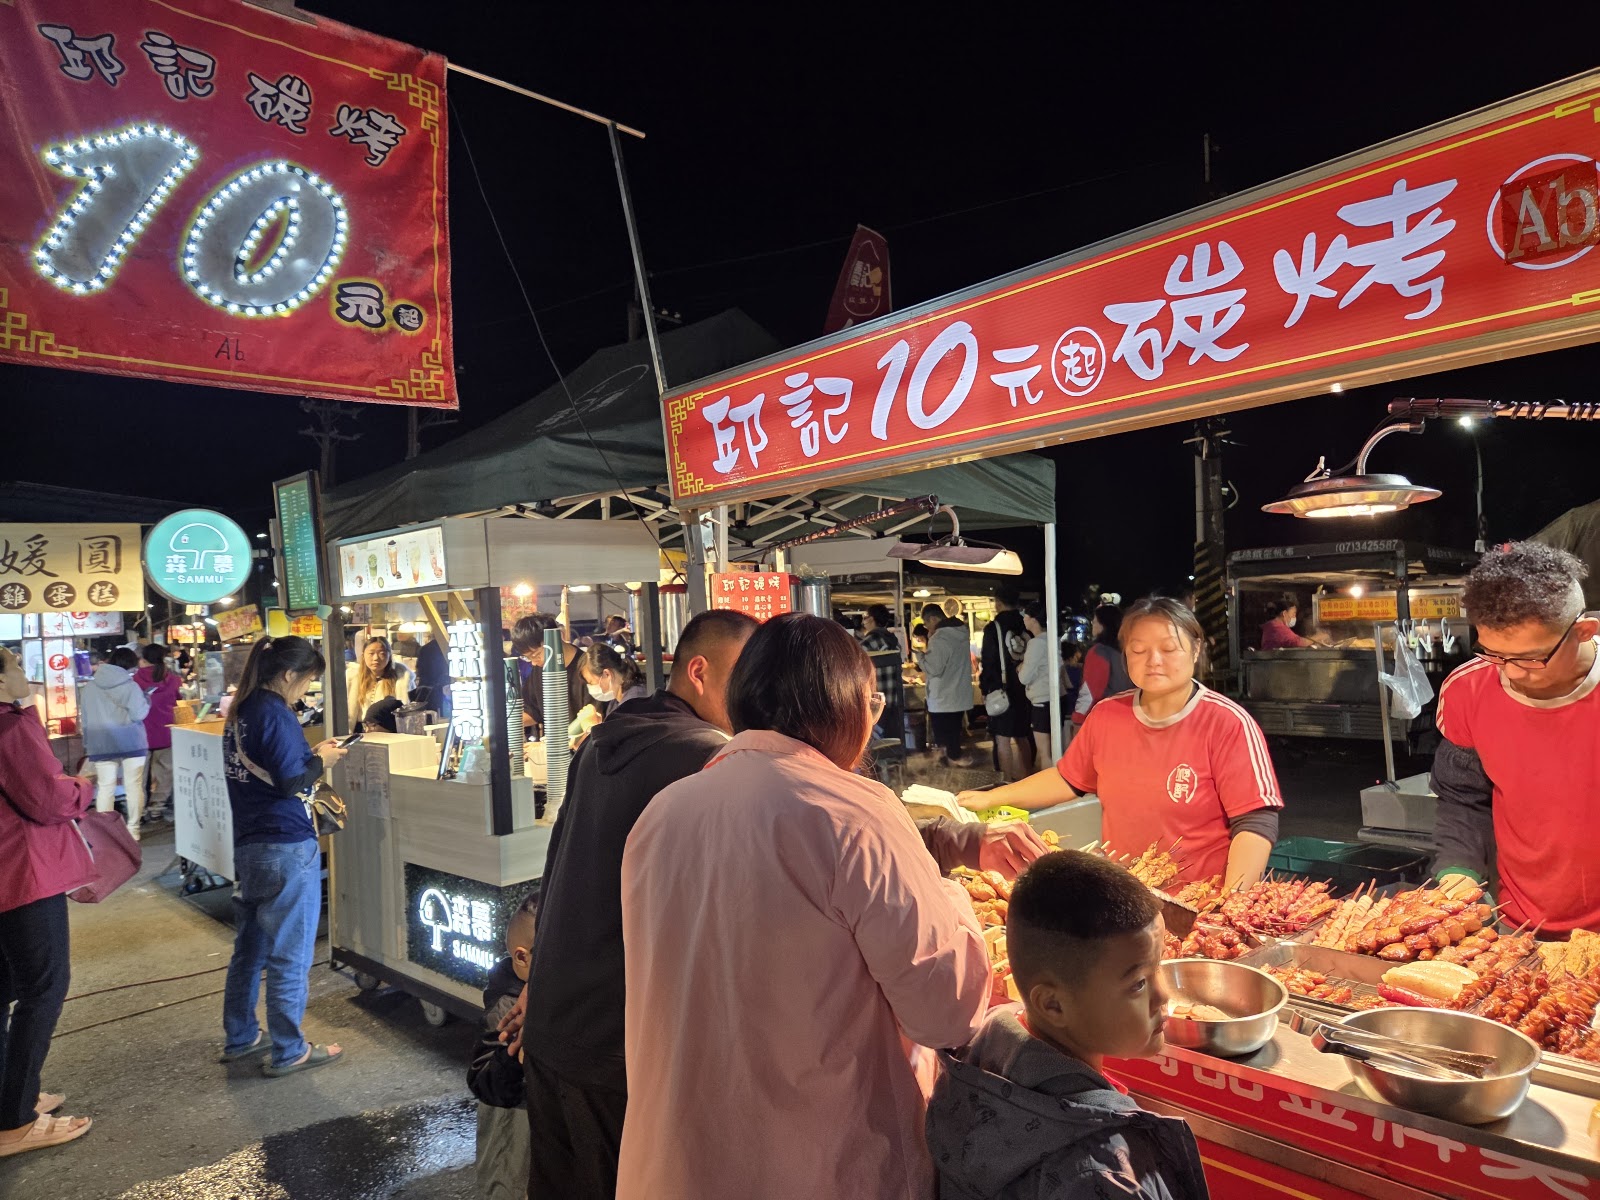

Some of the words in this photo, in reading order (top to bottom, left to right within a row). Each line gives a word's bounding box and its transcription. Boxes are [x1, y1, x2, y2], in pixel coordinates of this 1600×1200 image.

[215, 339, 246, 361] Ab
[177, 575, 224, 583] SAMMU
[1, 582, 118, 609] 雞蛋糕
